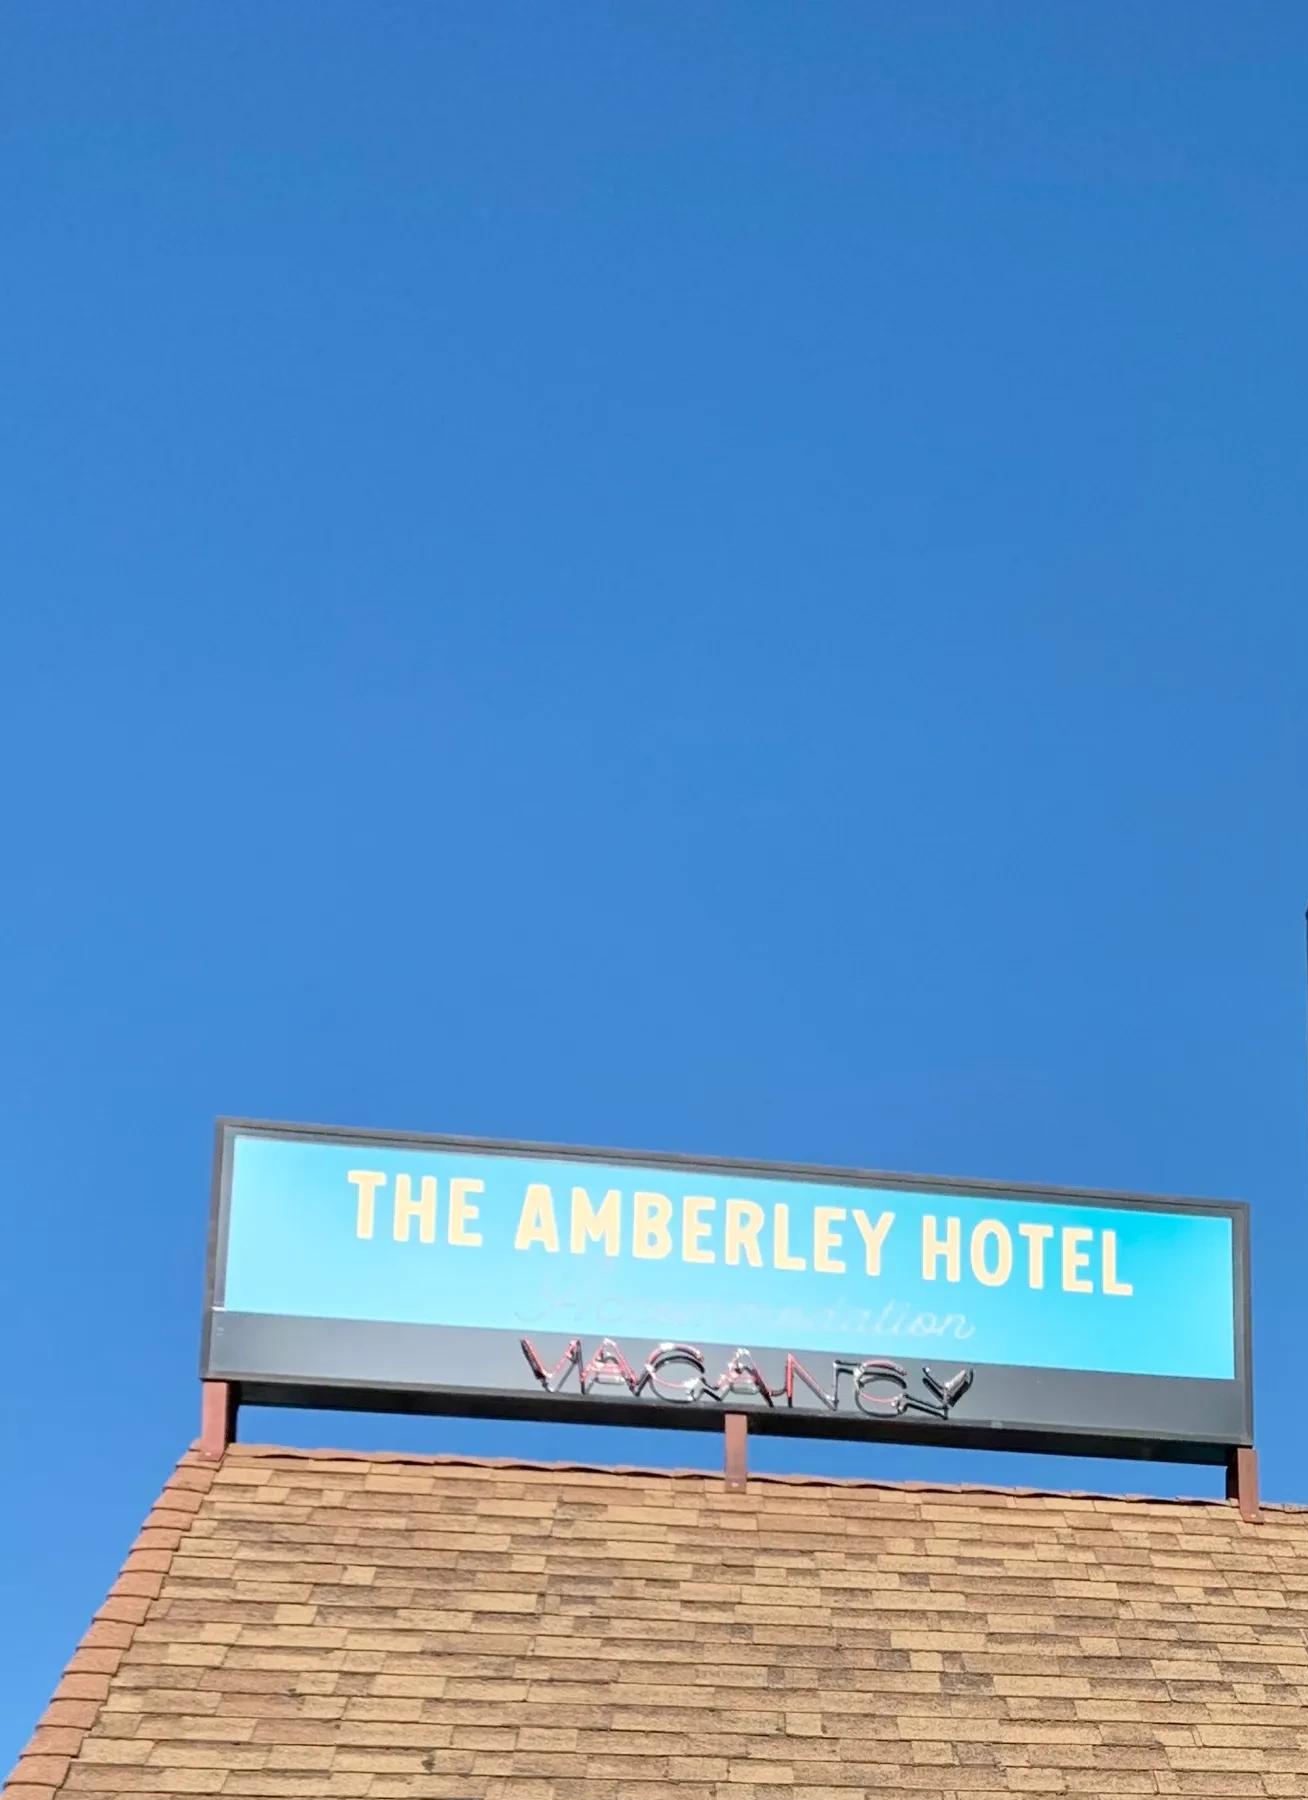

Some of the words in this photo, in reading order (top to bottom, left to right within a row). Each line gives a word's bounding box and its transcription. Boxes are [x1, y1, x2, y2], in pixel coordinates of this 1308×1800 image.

[347, 1168, 485, 1248] THE
[513, 1182, 895, 1277] AMBERLEY
[920, 1214, 1134, 1296] HOTEL
[519, 1336, 975, 1420] VACANCY
